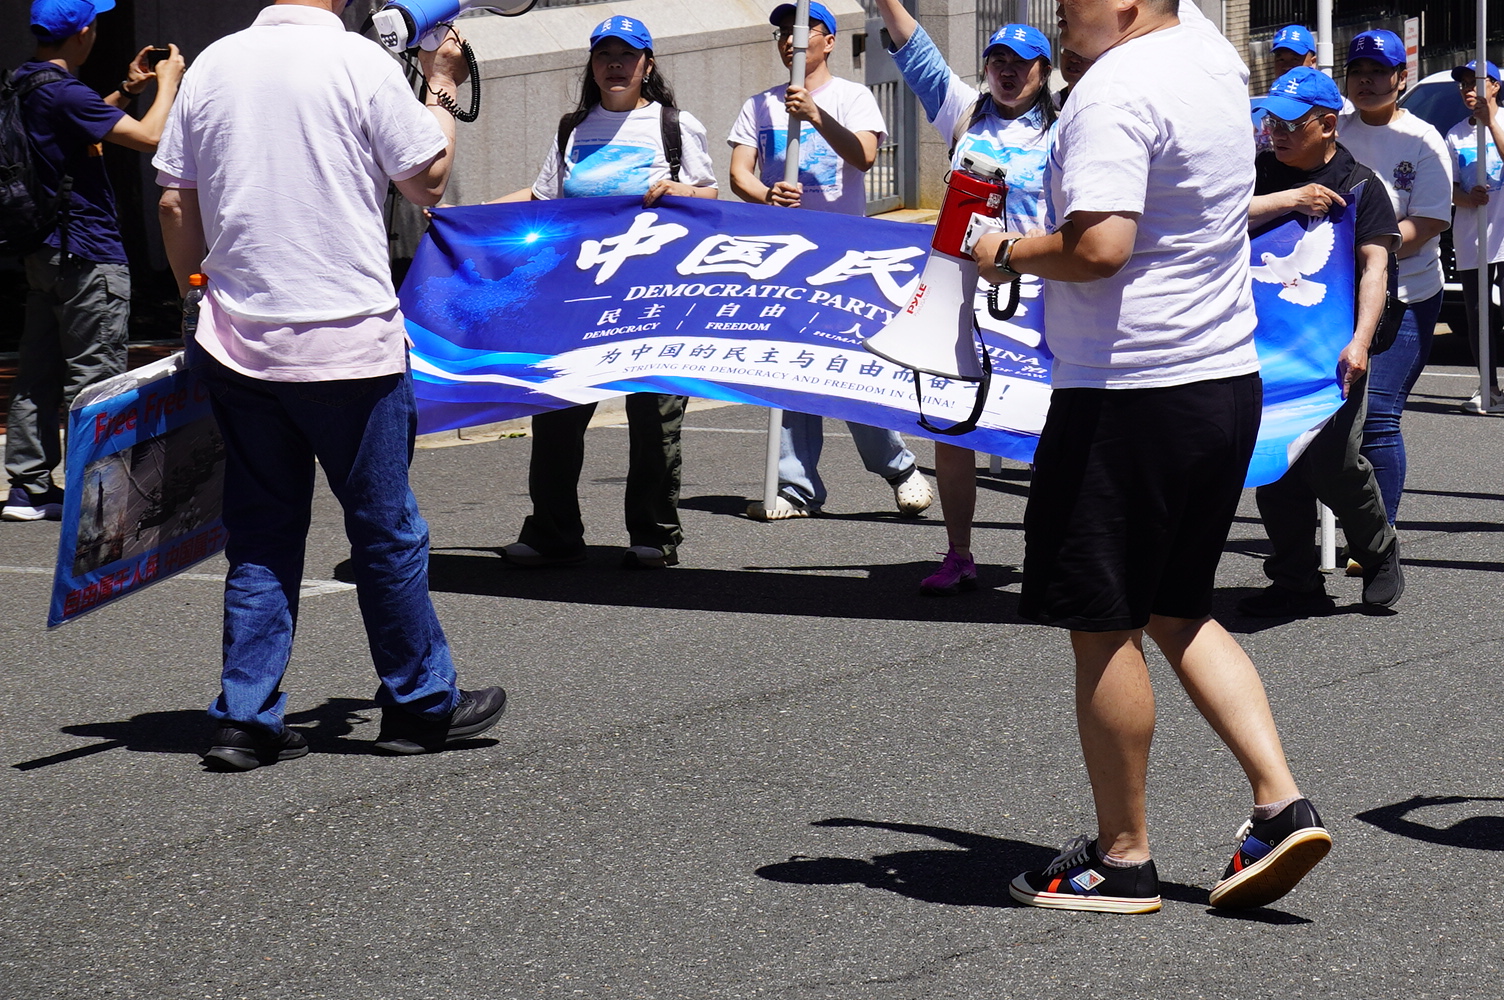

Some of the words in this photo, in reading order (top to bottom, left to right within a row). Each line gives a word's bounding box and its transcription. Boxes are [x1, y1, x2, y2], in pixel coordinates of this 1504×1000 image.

[1355, 35, 1385, 52] 民主
[906, 282, 928, 315] PYLE
[582, 321, 662, 340] DEMOCRACY
[705, 321, 772, 331] FREEDOM
[597, 303, 666, 326] 民主
[716, 302, 786, 318] 自由
[839, 322, 865, 339] 人
[623, 283, 808, 301] DEMOCRATIC
[808, 290, 897, 327] PARTY
[974, 341, 1040, 366] HINA
[622, 363, 678, 374] STRIVING
[681, 363, 707, 373] FOR
[709, 365, 790, 380] DEMOCRACY
[791, 374, 820, 385] AND
[823, 378, 886, 395] FREEDOM
[890, 389, 905, 398] IN
[94, 412, 138, 444] Free
[144, 388, 186, 423] Free
